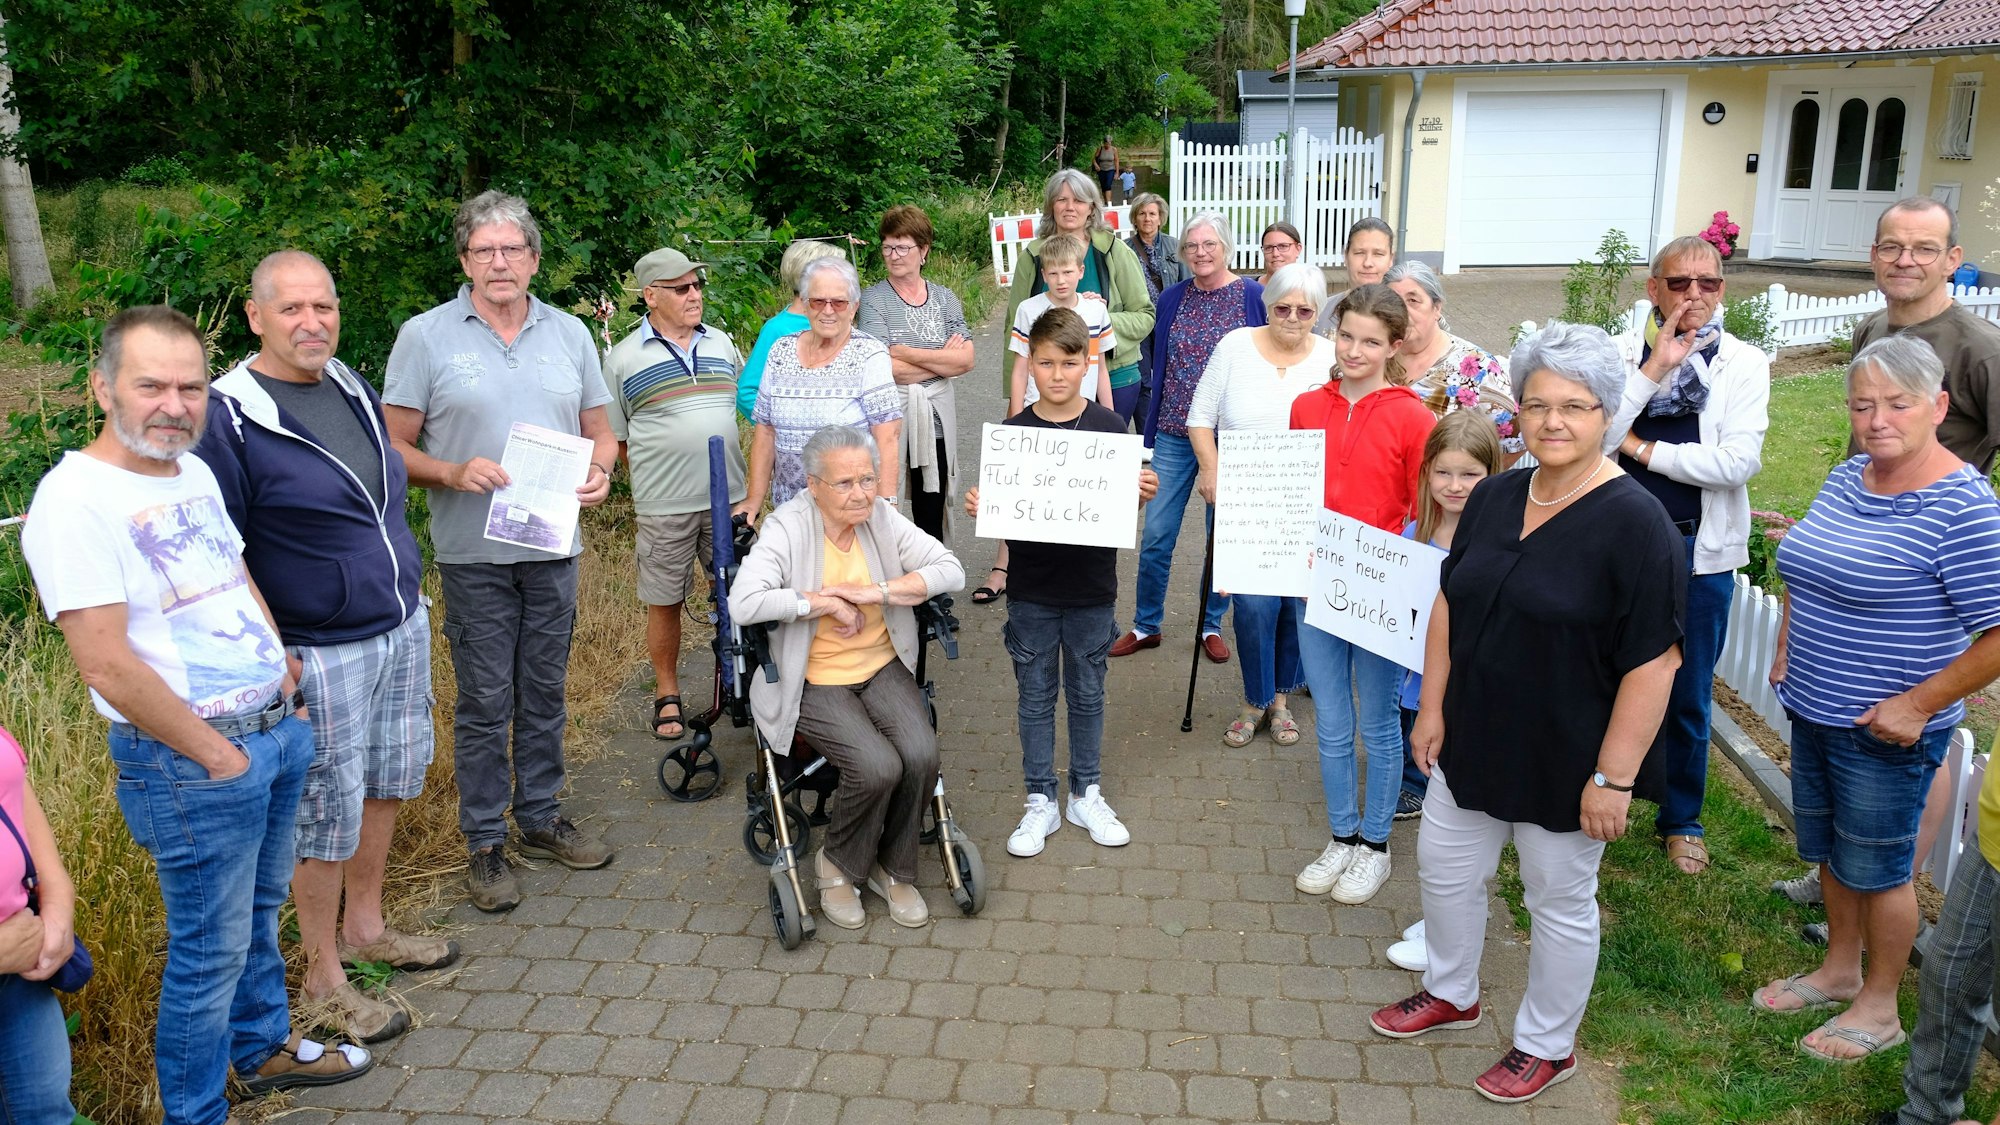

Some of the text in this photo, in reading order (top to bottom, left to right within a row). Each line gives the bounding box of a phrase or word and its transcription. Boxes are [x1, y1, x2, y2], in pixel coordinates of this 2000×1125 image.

[453, 352, 481, 362] BASE
[990, 429, 1116, 467] Schlug die
[1240, 433, 1252, 441] ein
[1263, 442, 1275, 453] für
[984, 463, 1108, 491] Flut sie auch
[986, 499, 1100, 523] in Stücke
[1318, 518, 1409, 568] wir fordern
[1316, 544, 1386, 583] eine neue
